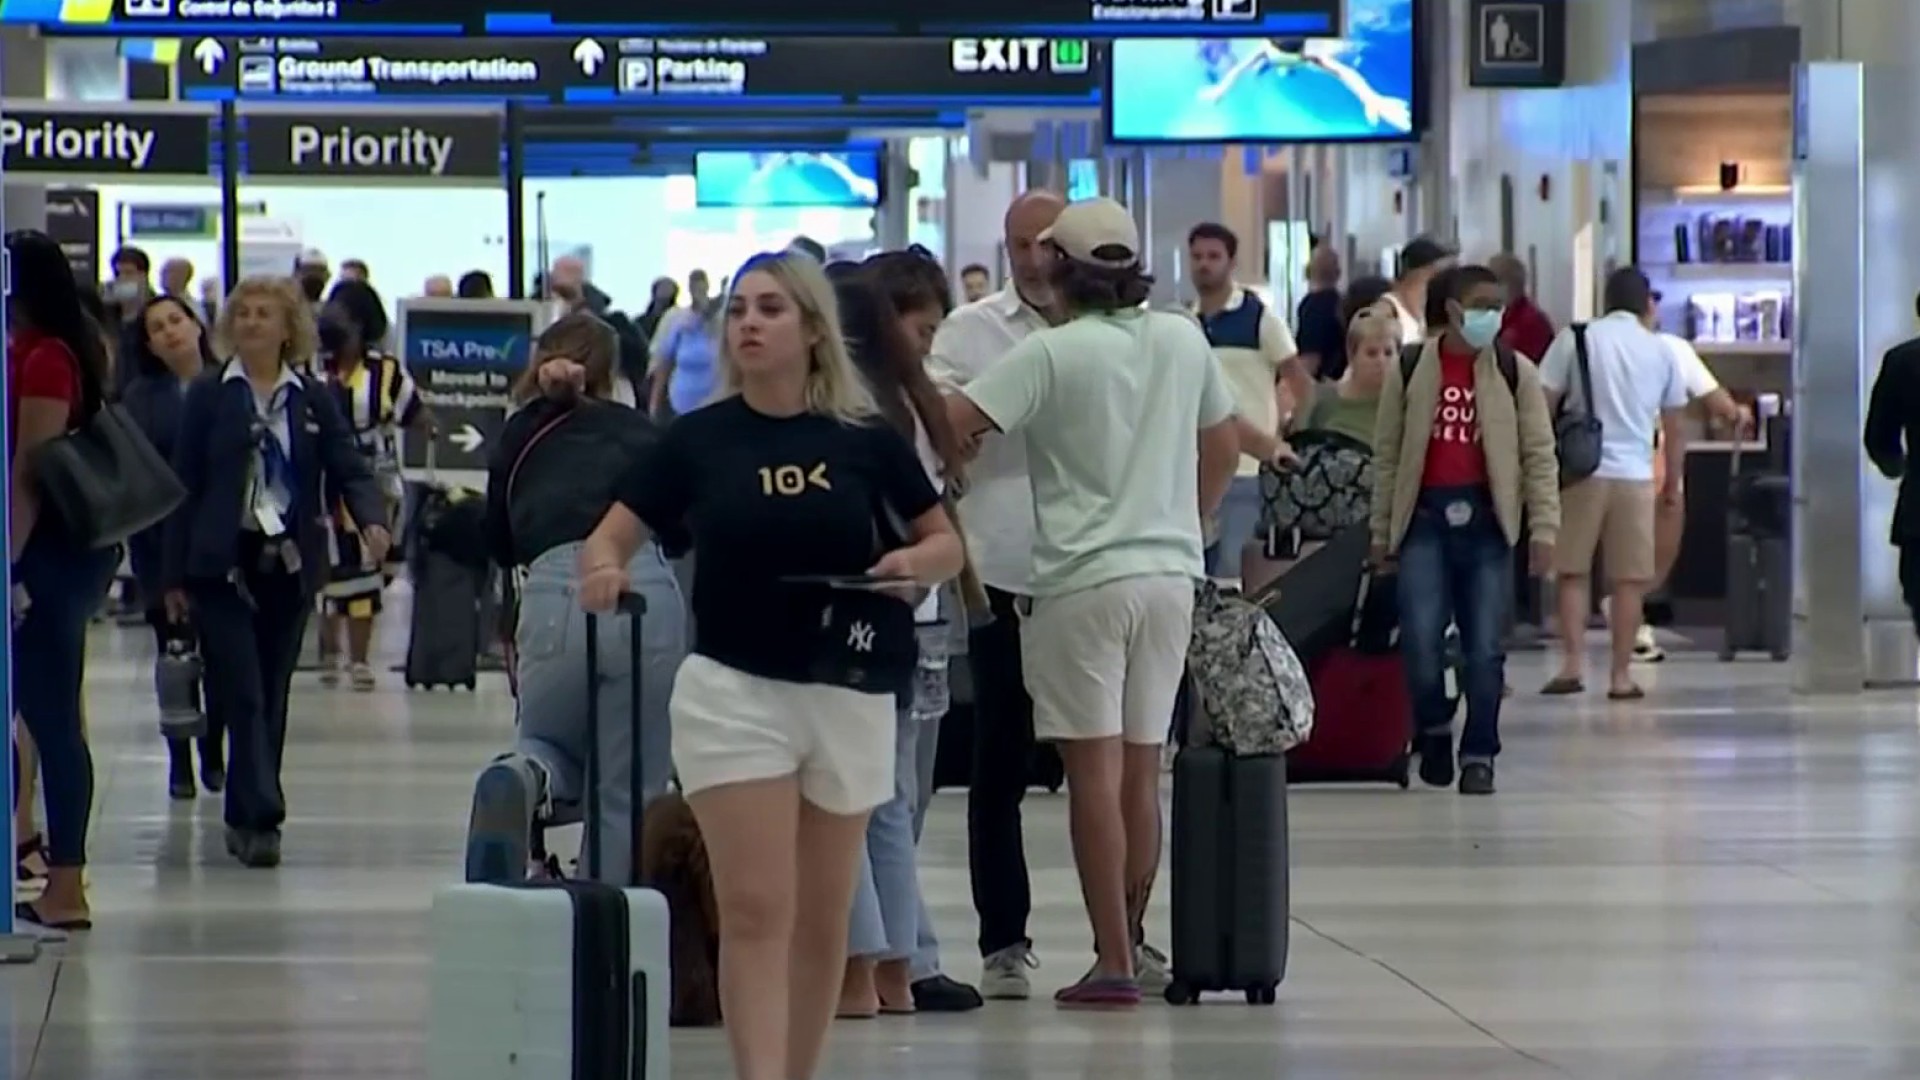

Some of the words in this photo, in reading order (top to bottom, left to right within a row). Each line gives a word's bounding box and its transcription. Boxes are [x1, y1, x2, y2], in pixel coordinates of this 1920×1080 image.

[278, 56, 365, 80] Ground
[367, 57, 537, 84] Transportation
[952, 38, 1047, 72] EXIT
[656, 57, 745, 85] Parking
[0, 120, 155, 168] Priority
[290, 126, 453, 174] Priority
[420, 339, 461, 359] TSA
[431, 370, 487, 386] Moved
[489, 371, 508, 387] to
[846, 620, 877, 652] NY
